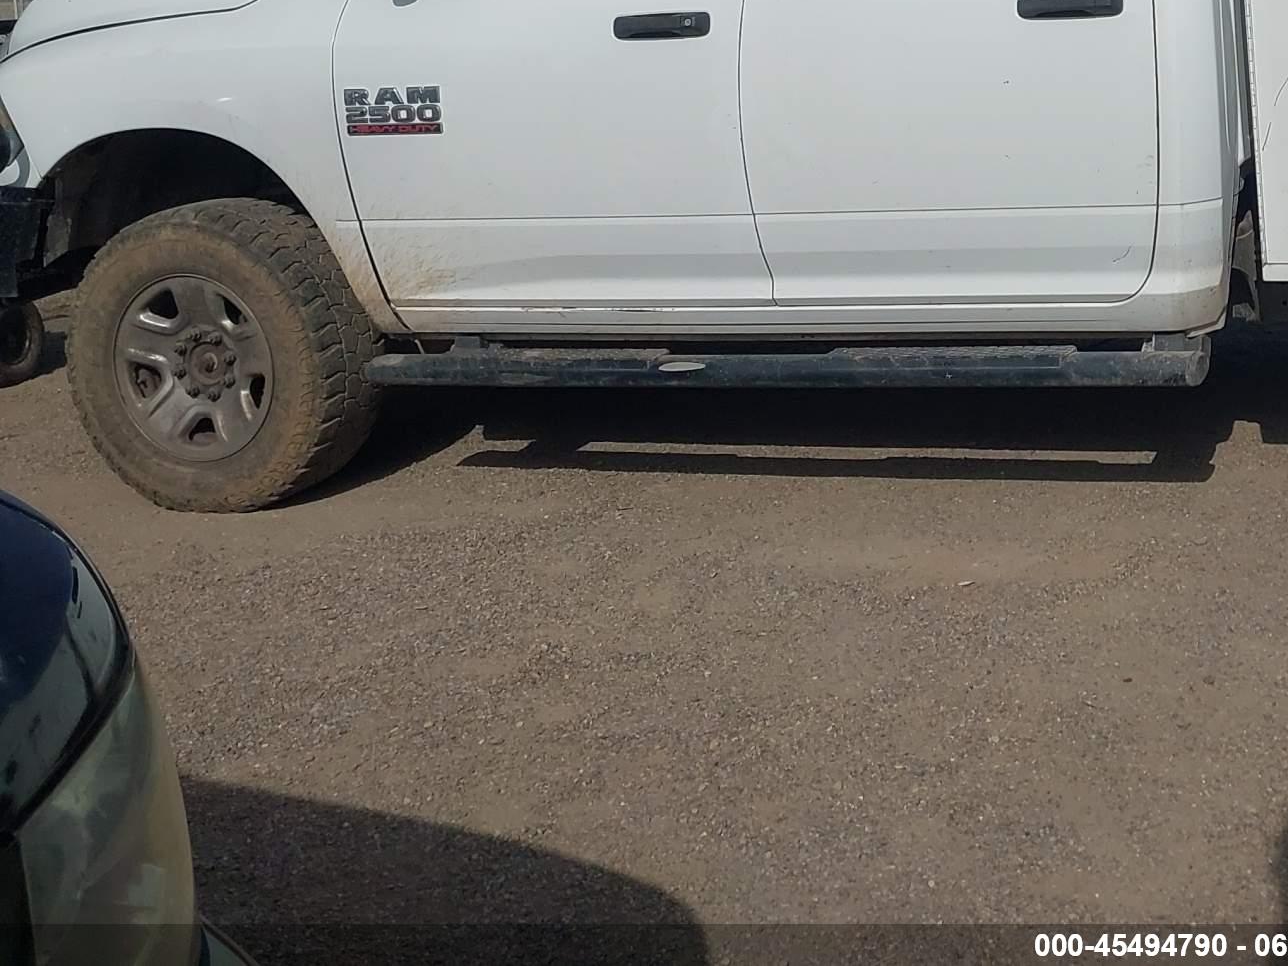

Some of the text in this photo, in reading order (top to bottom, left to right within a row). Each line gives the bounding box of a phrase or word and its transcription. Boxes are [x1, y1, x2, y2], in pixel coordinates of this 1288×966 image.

[343, 86, 441, 106] RAM
[345, 104, 442, 124] 2500
[351, 124, 438, 134] HEAVY DUTY
